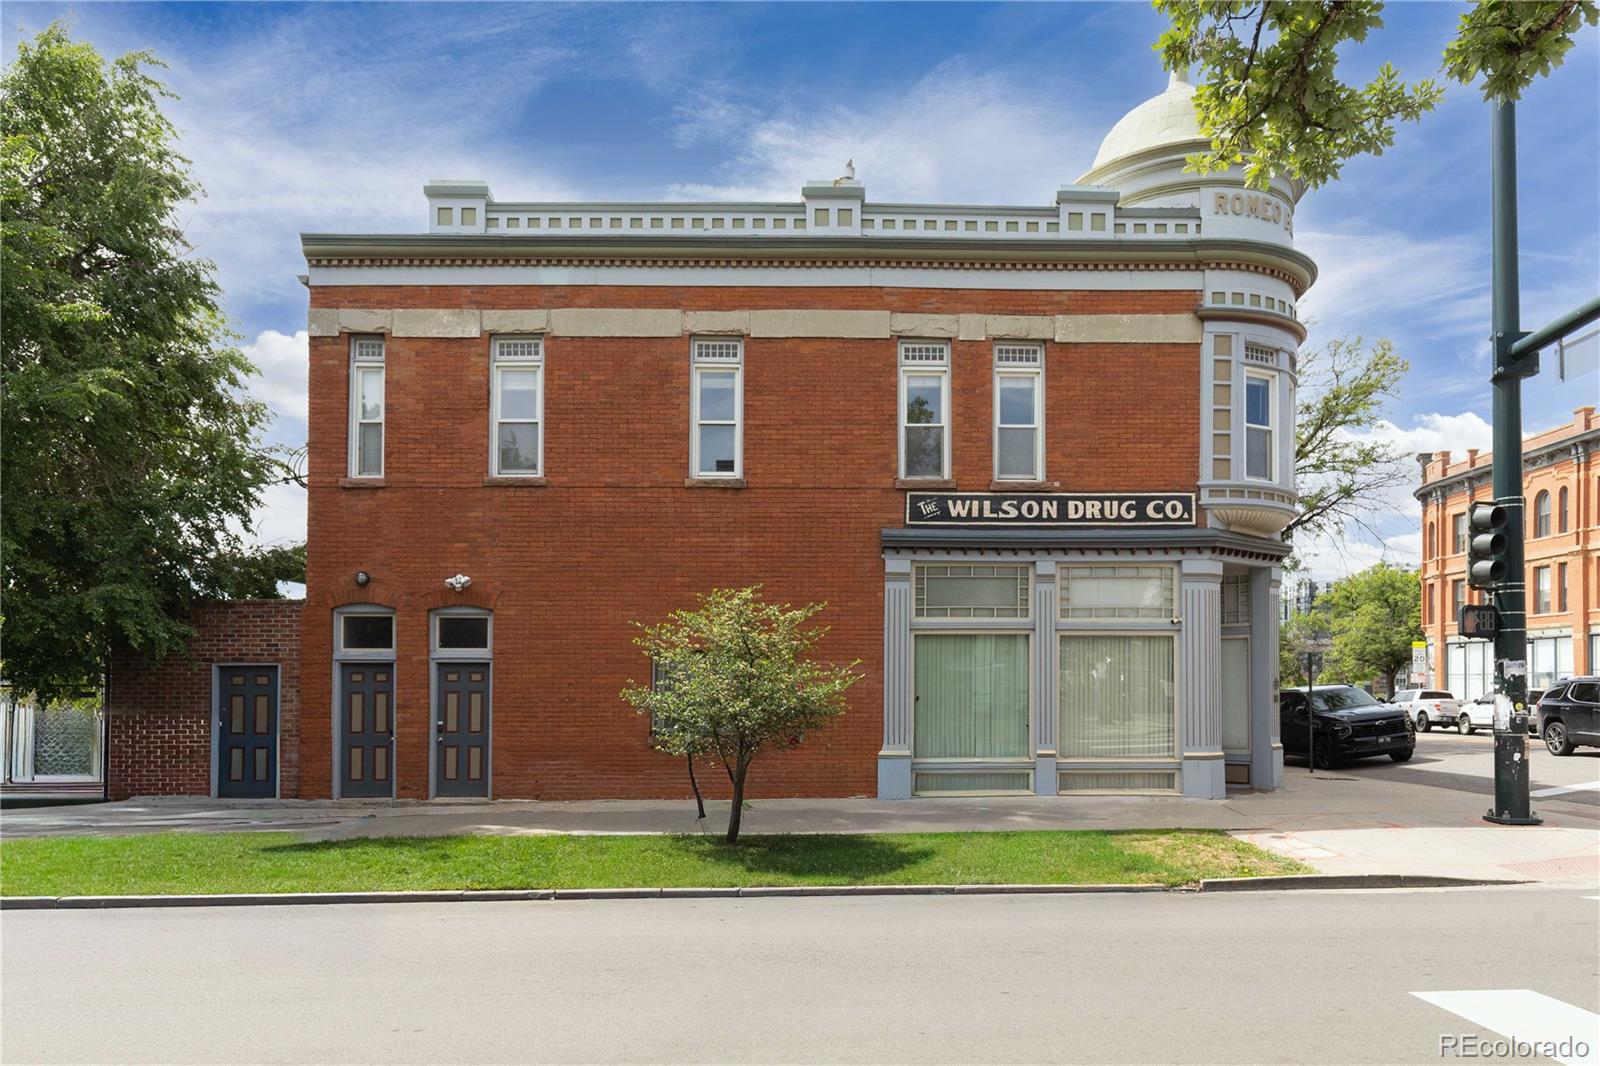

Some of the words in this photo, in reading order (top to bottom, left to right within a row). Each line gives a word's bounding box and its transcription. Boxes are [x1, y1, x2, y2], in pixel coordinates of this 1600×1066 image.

[1214, 192, 1282, 225] ROMEO
[917, 500, 938, 515] THE
[947, 499, 1057, 519] WILSON
[1067, 499, 1137, 520] DRUG
[1146, 499, 1190, 519] CO.
[1414, 655, 1425, 663] 20
